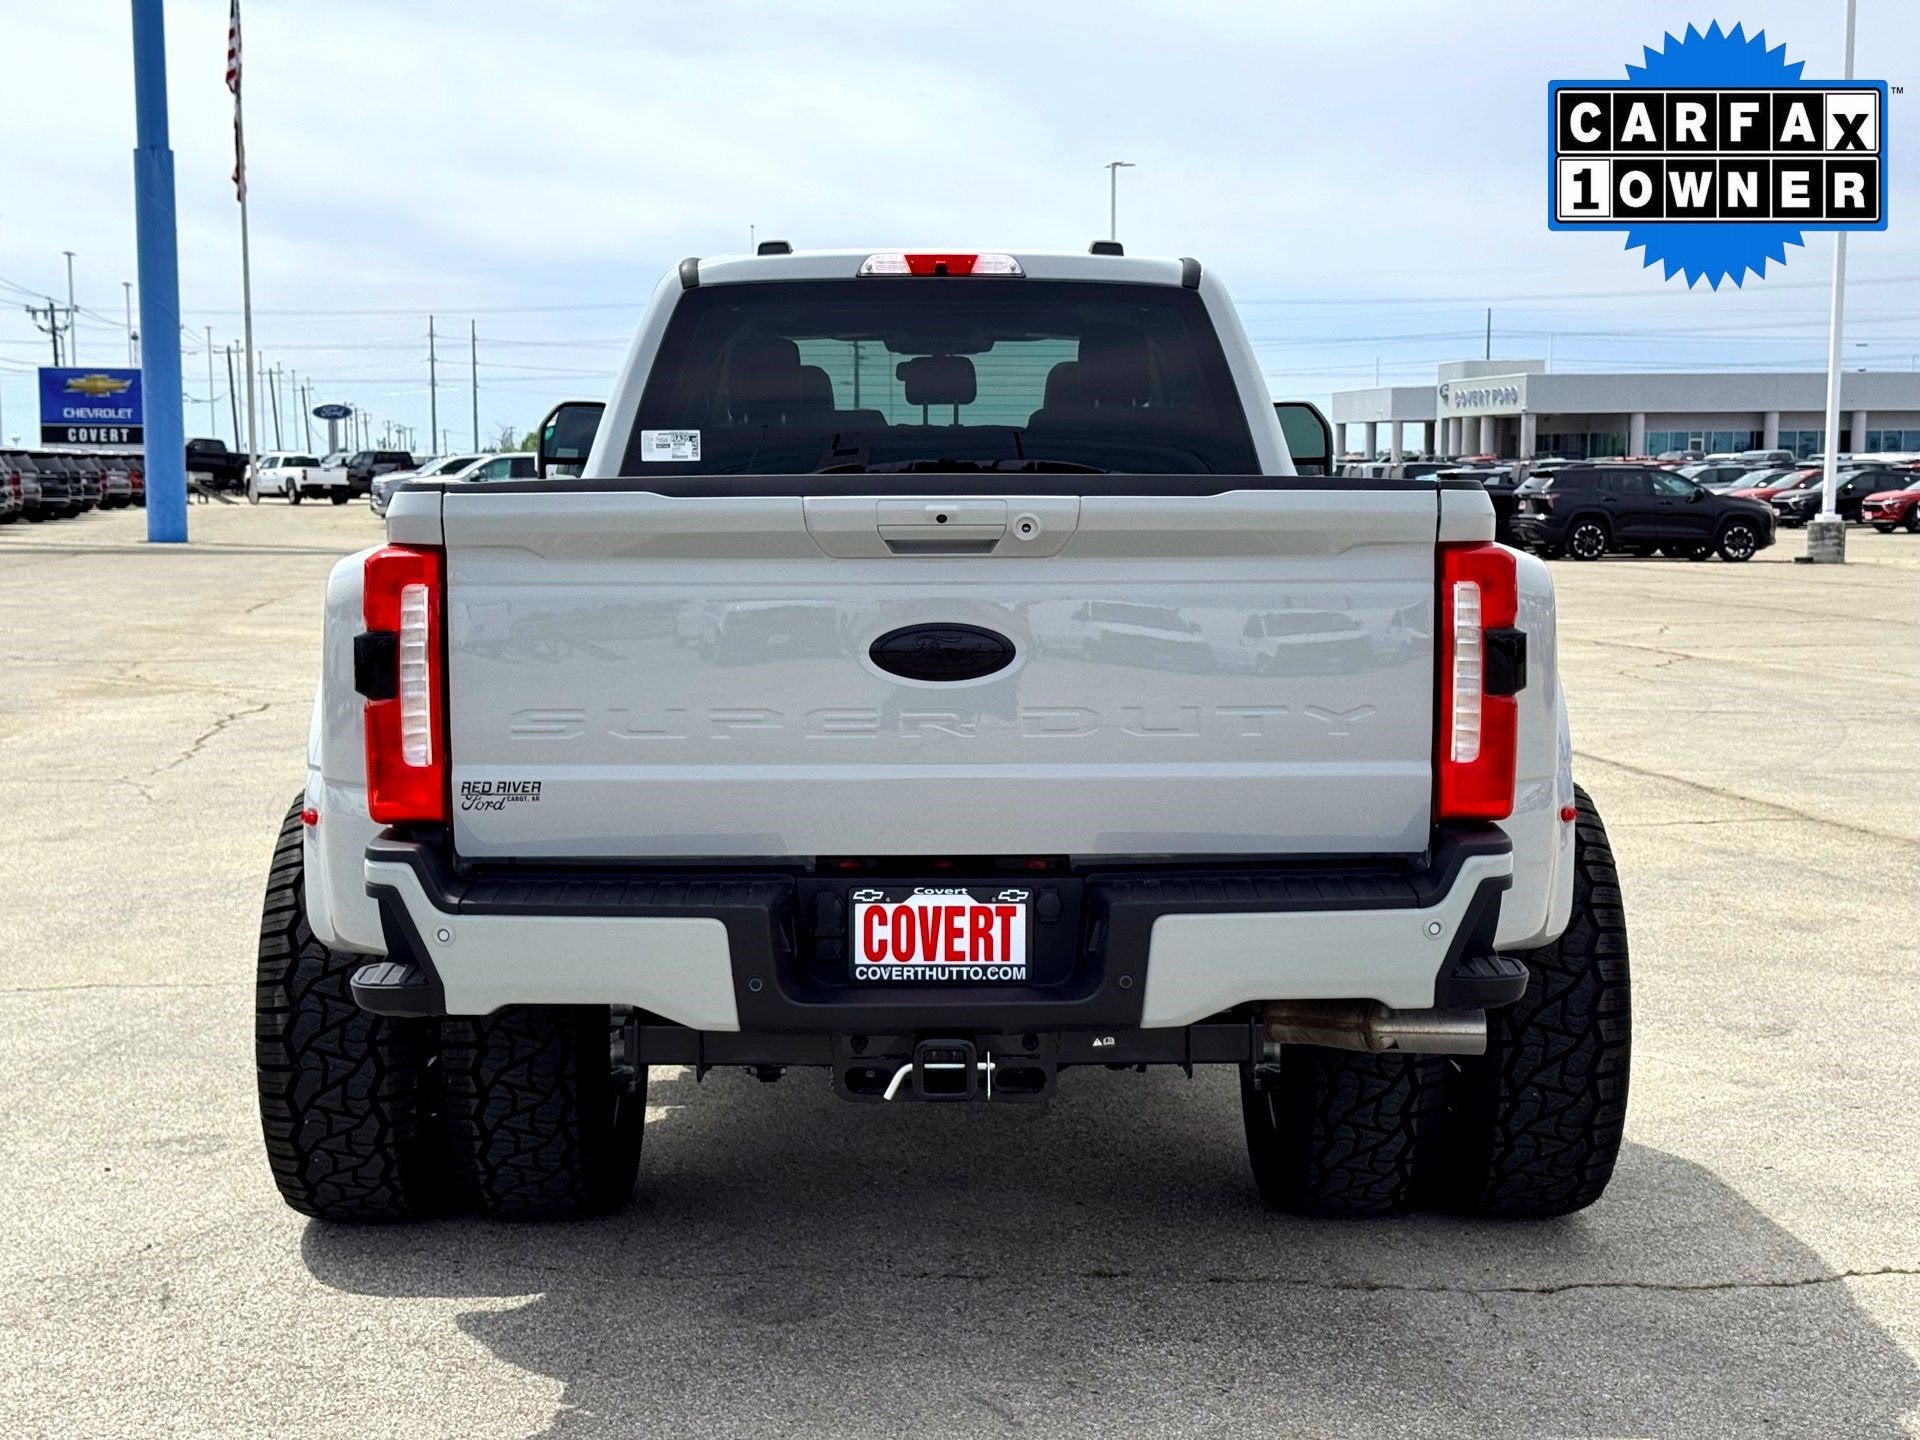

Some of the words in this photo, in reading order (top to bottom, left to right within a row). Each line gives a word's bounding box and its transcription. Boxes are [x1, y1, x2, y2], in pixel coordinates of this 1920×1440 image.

[63, 407, 133, 419] CHEVROLET
[67, 428, 129, 442] COVERT
[510, 706, 978, 740] SUPER
[1021, 705, 1377, 738] DUTY
[461, 781, 492, 793] RED
[497, 781, 541, 793] RIVER
[461, 790, 506, 811] Ford
[913, 887, 968, 895] Covert
[863, 905, 1016, 962] COVERT
[855, 966, 1026, 980] COVERTHUTTO.COM
